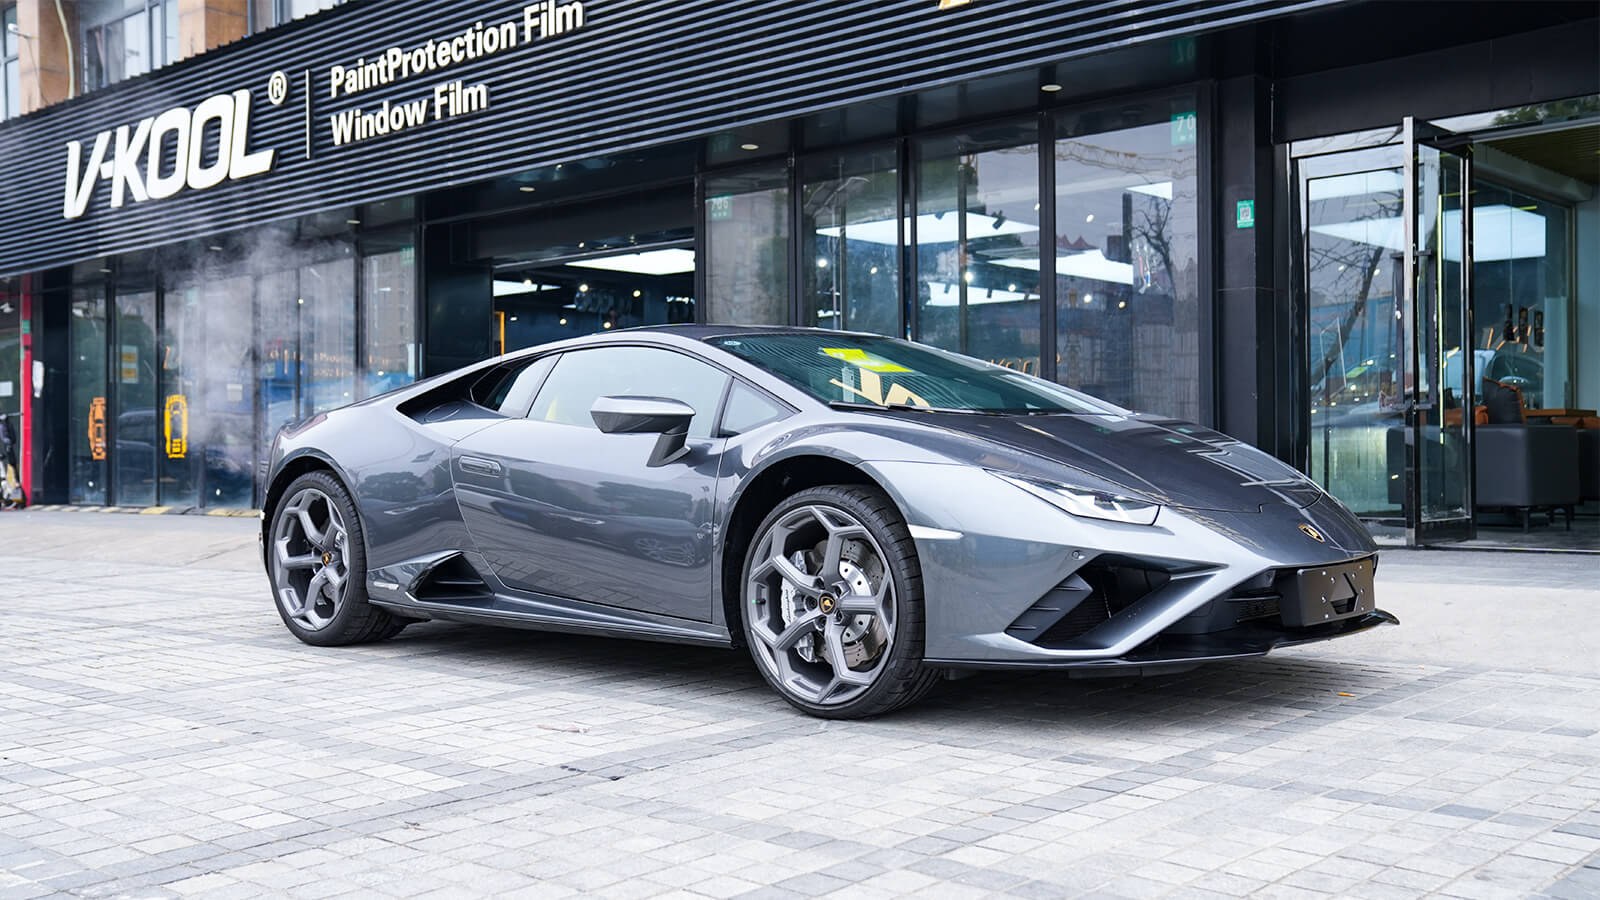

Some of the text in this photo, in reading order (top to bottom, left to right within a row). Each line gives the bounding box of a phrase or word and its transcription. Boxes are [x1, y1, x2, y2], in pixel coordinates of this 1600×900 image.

[331, 0, 584, 98] PaintProtection Film
[63, 88, 275, 219] V-KOOL
[330, 79, 488, 146] Window Film
